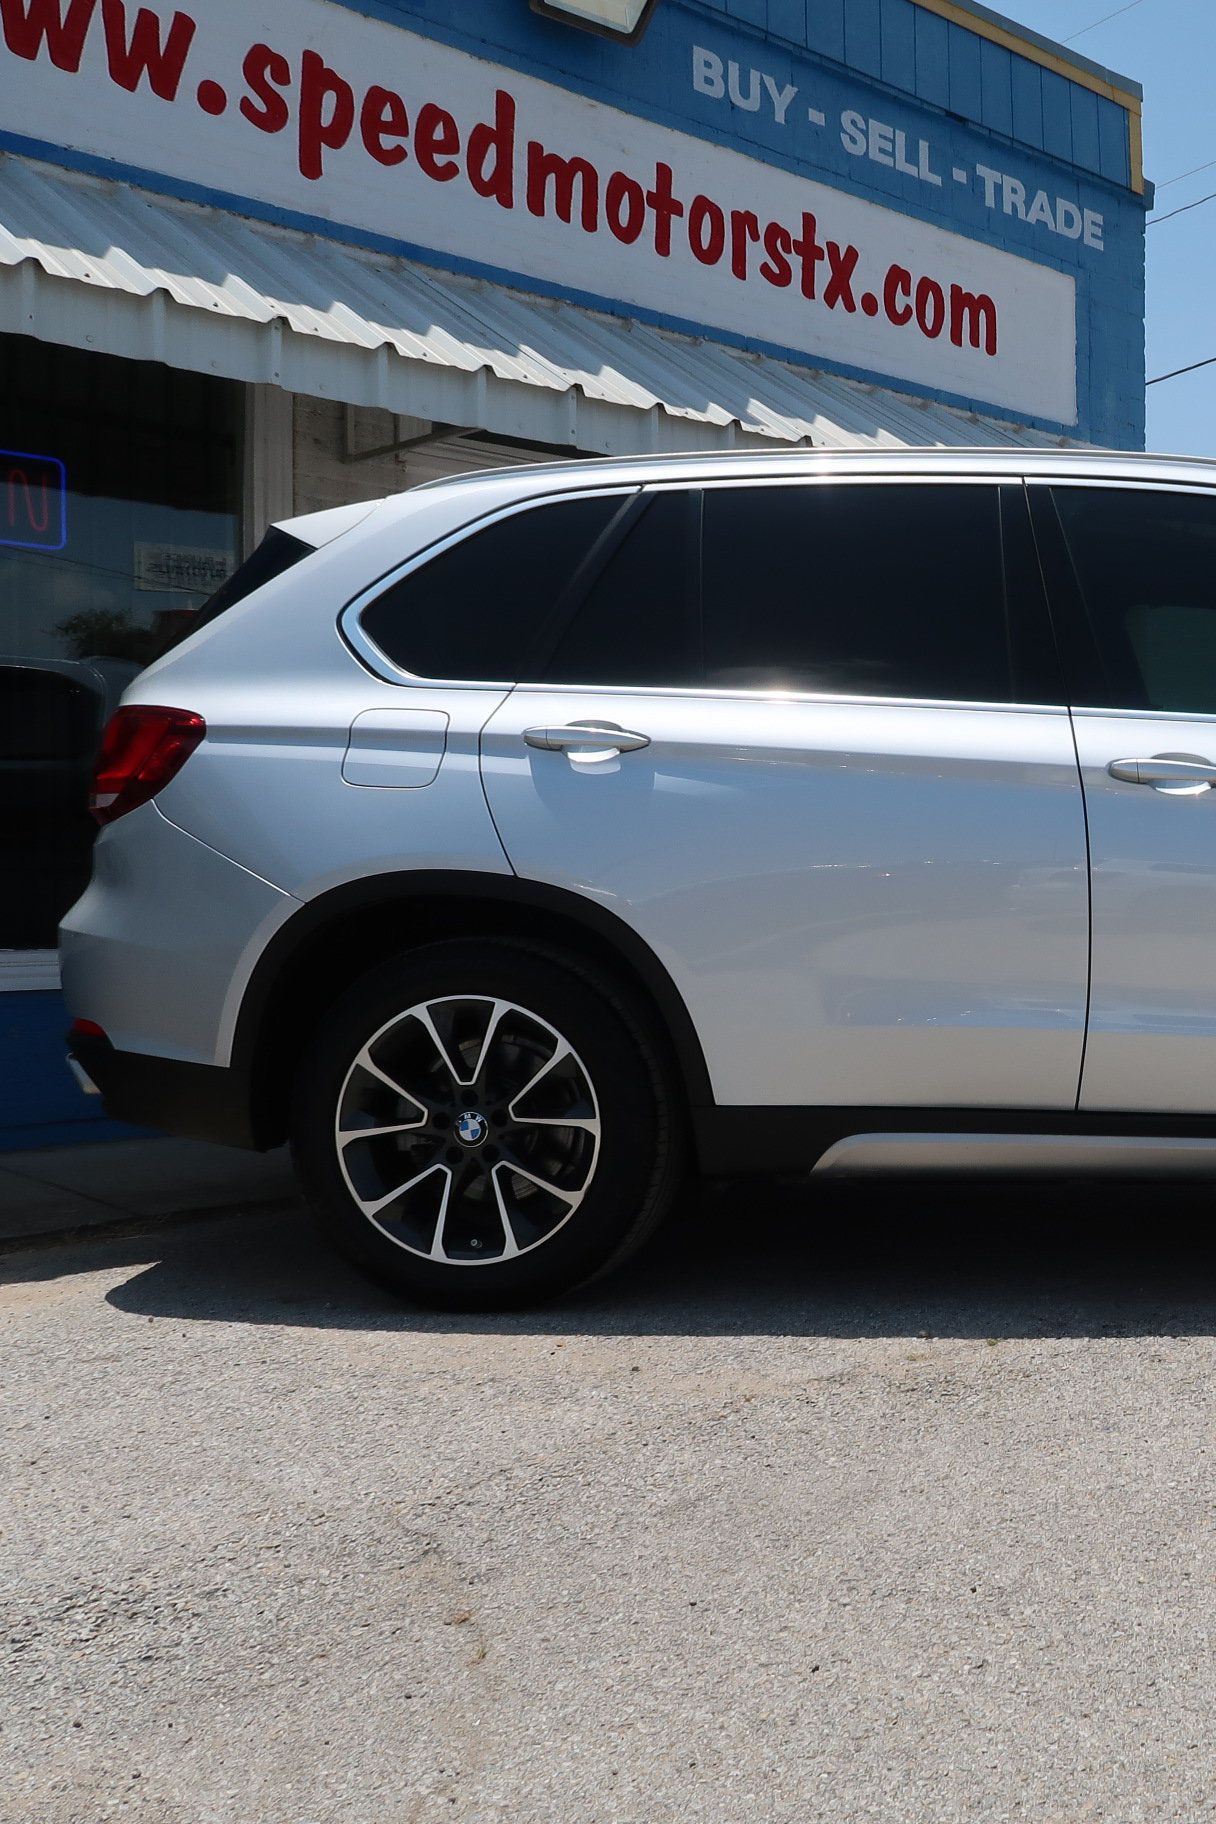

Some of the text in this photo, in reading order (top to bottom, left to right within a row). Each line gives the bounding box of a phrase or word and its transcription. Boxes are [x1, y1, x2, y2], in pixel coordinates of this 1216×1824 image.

[691, 44, 799, 126] BUY
[839, 108, 943, 187] SELL
[975, 162, 1105, 252] TRADE
